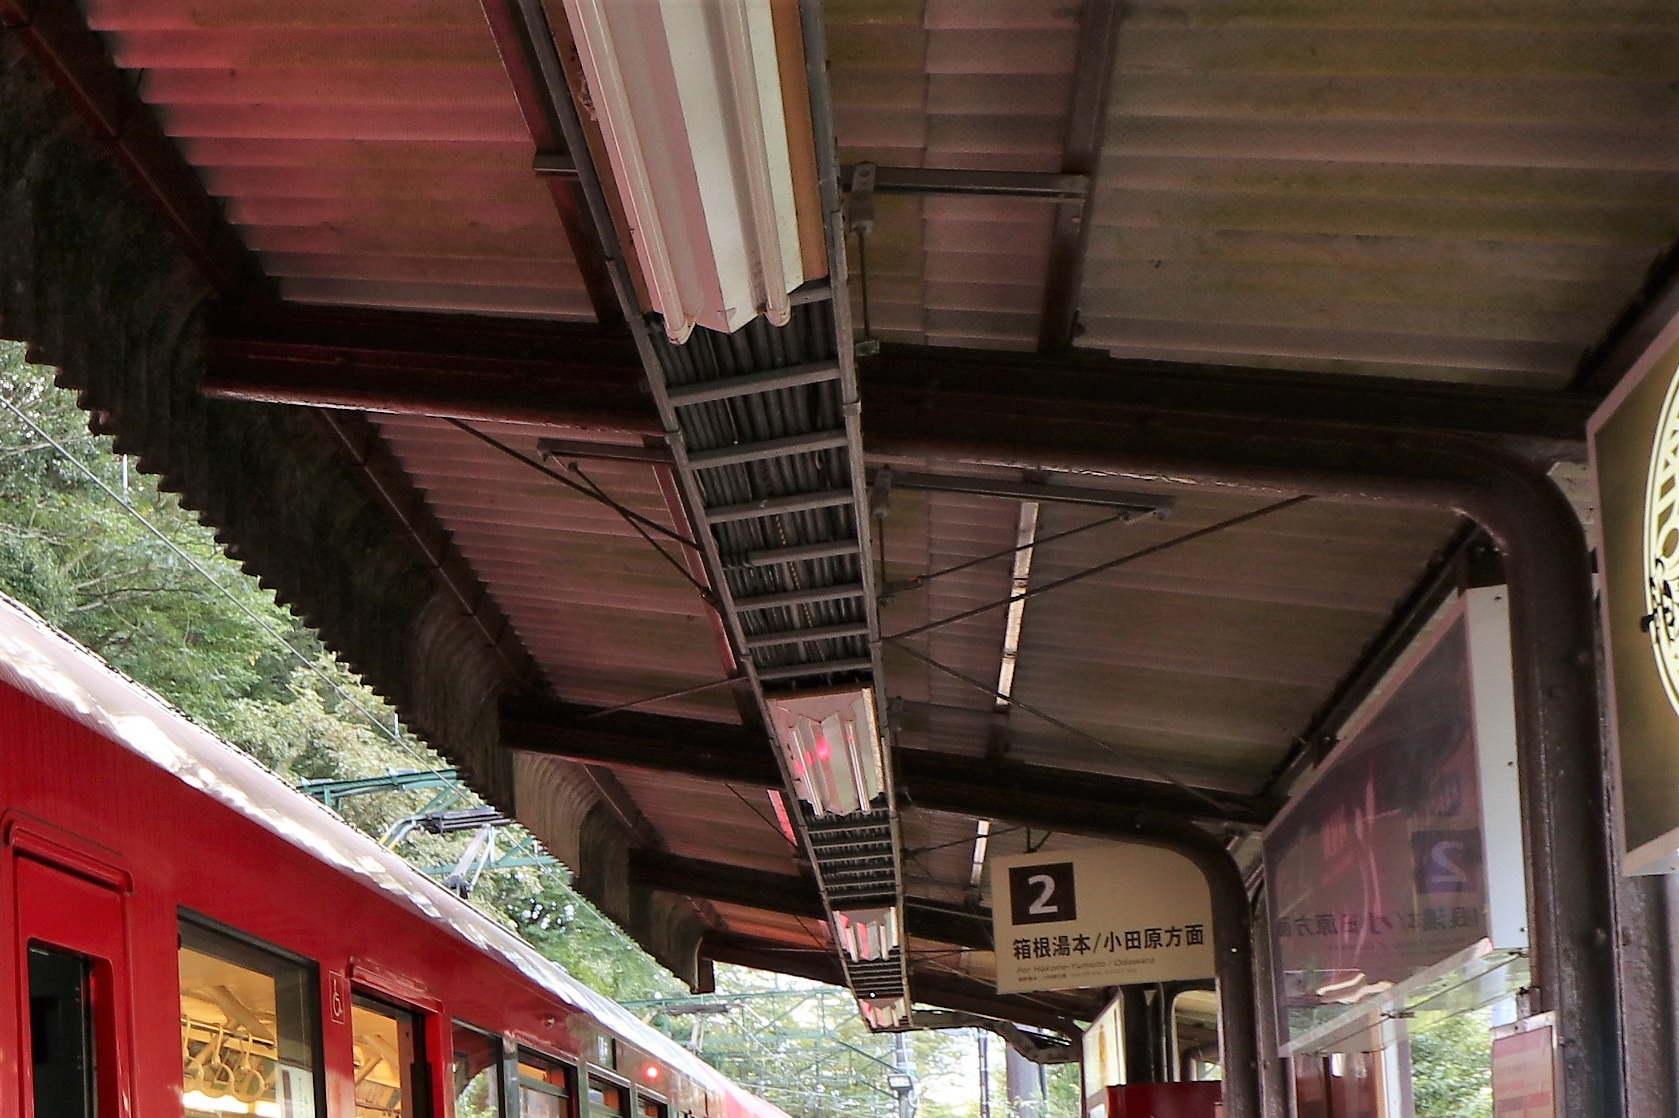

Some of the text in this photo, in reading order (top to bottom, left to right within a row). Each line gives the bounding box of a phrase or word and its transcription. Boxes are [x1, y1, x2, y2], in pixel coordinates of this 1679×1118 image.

[1027, 873, 1059, 915] 2
[1012, 923, 1205, 961] 箱根湯本/小田原方面
